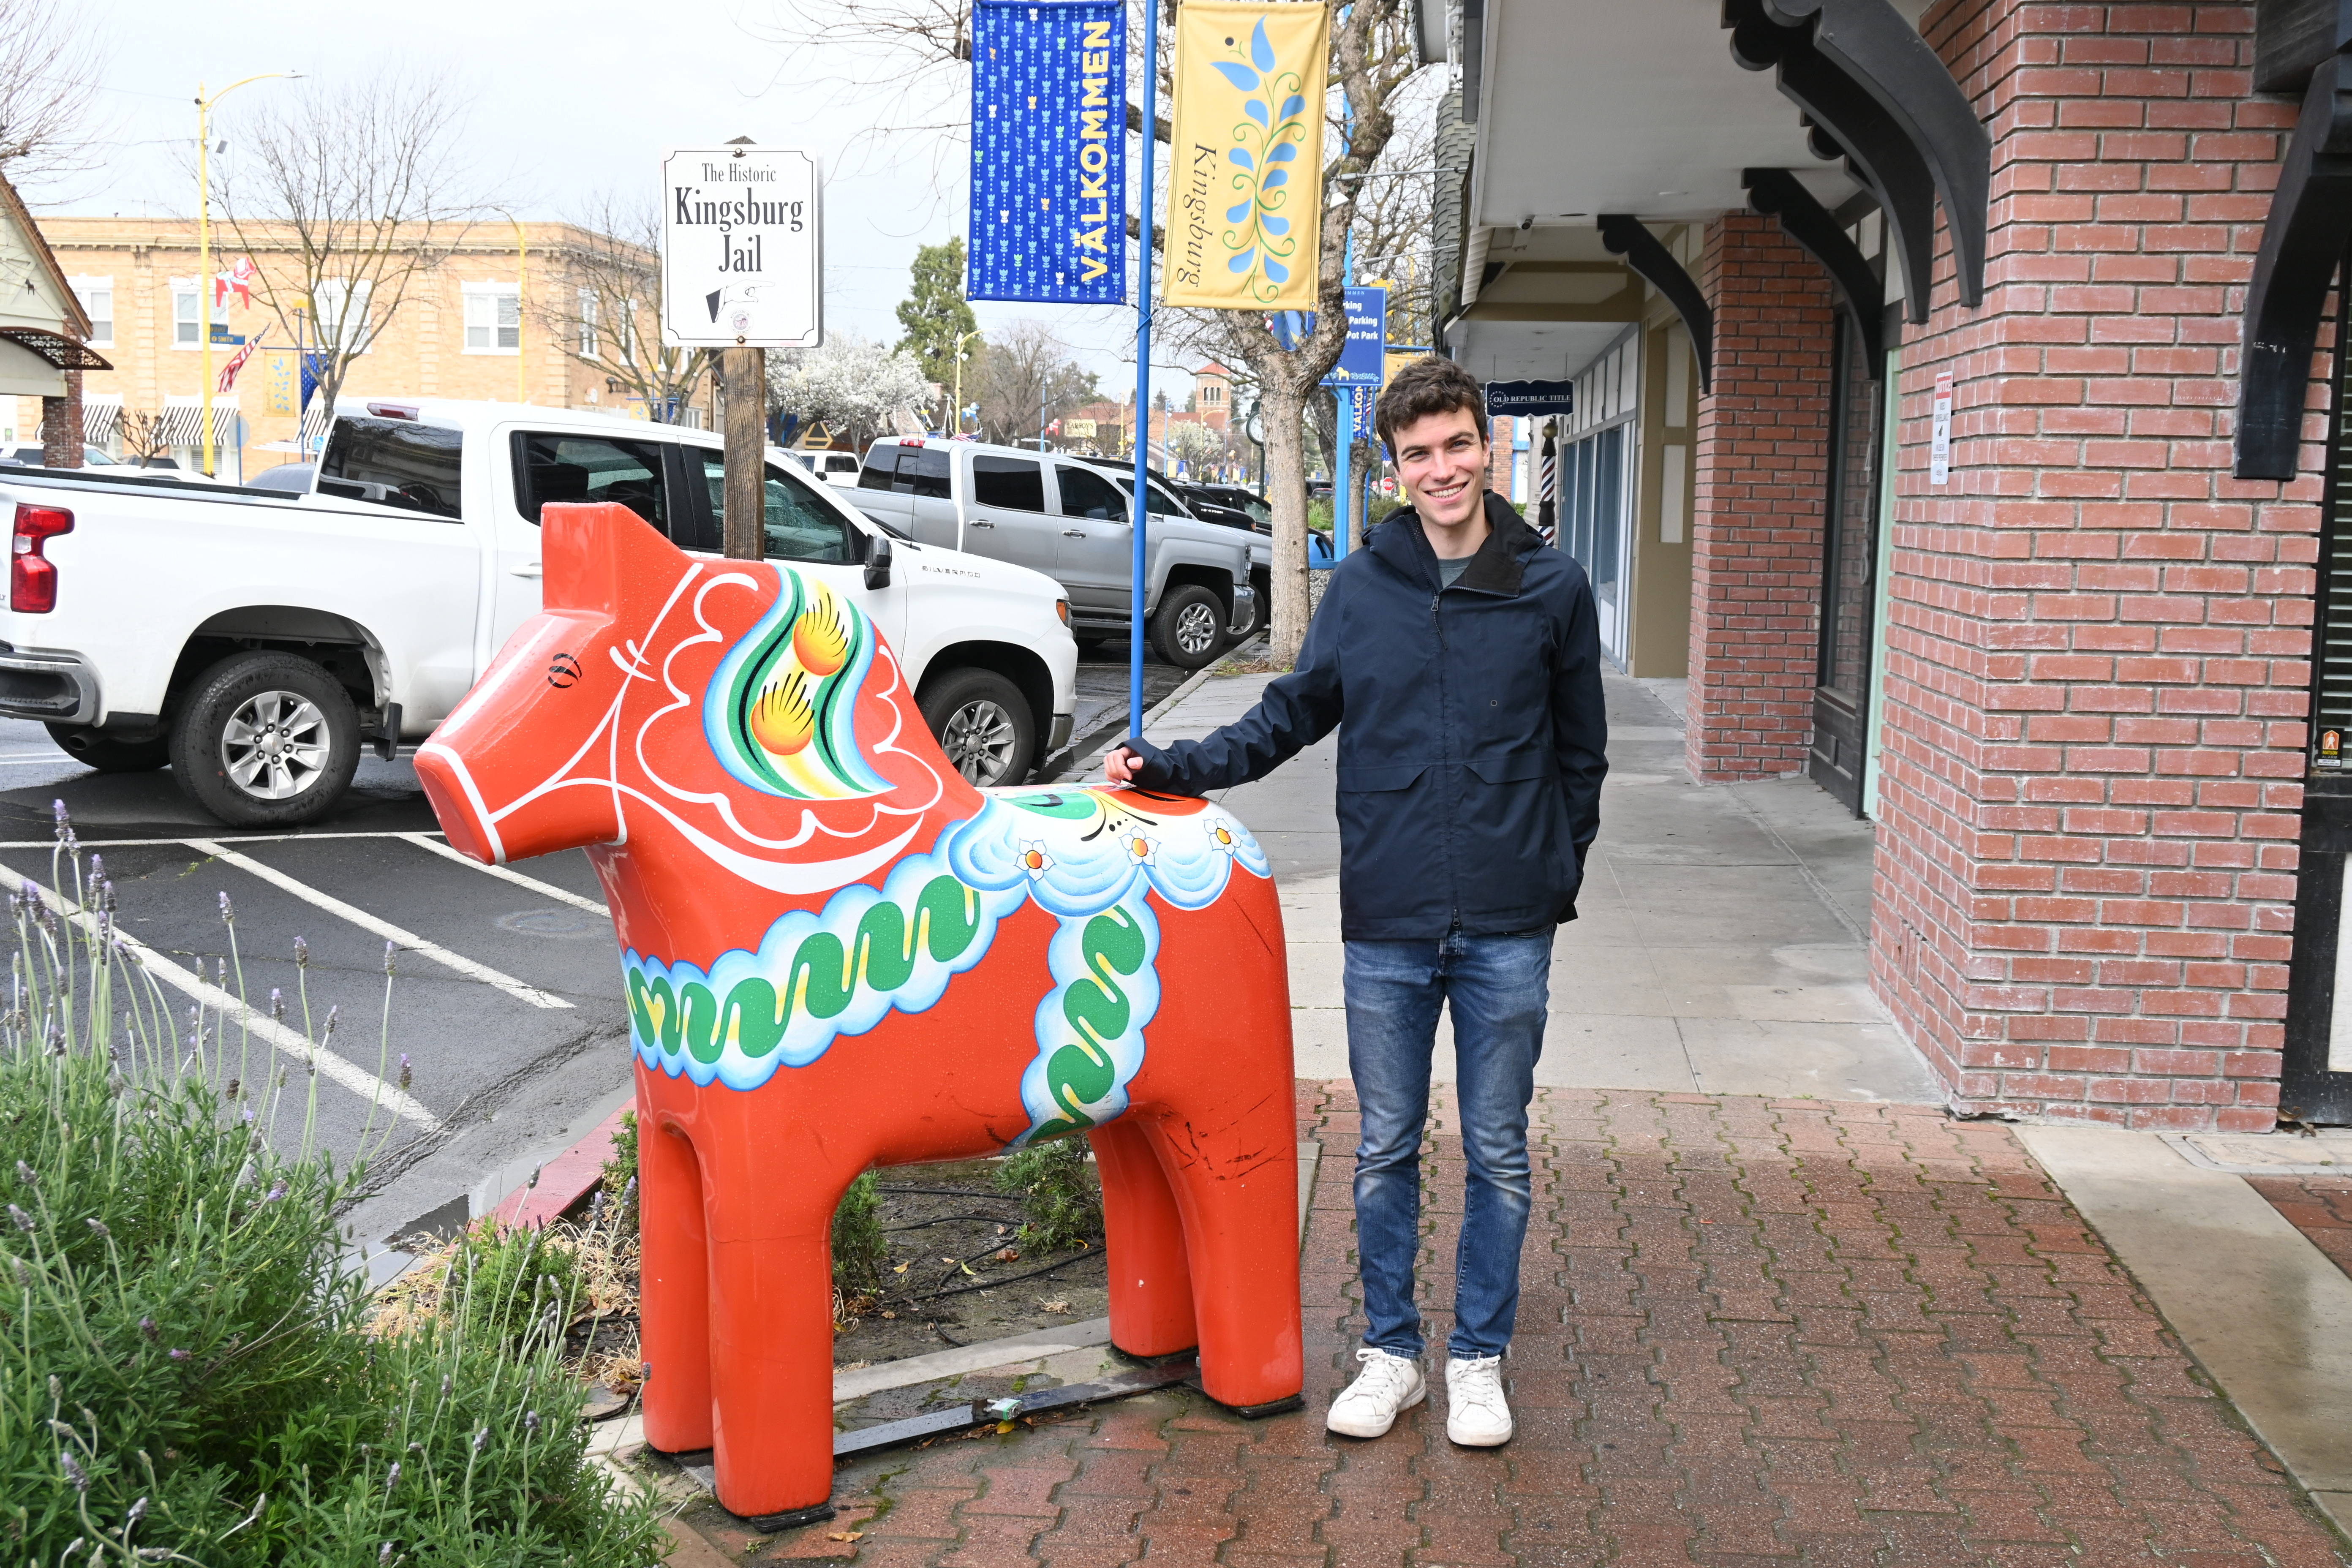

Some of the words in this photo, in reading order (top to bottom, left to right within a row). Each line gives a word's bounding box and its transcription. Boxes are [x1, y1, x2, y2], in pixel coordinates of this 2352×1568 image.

[1074, 22, 1111, 282] VÄLKOMMEN
[702, 163, 724, 182] The
[729, 163, 776, 182] Historic
[675, 187, 803, 232] Kingsburg
[1177, 141, 1217, 288] Kingsburg
[718, 234, 762, 272] Jail
[1342, 300, 1362, 312] rking
[1348, 316, 1378, 327] Parking
[1346, 331, 1360, 340] Pot
[1361, 331, 1378, 340] Park
[922, 566, 980, 578] SILVERADO
